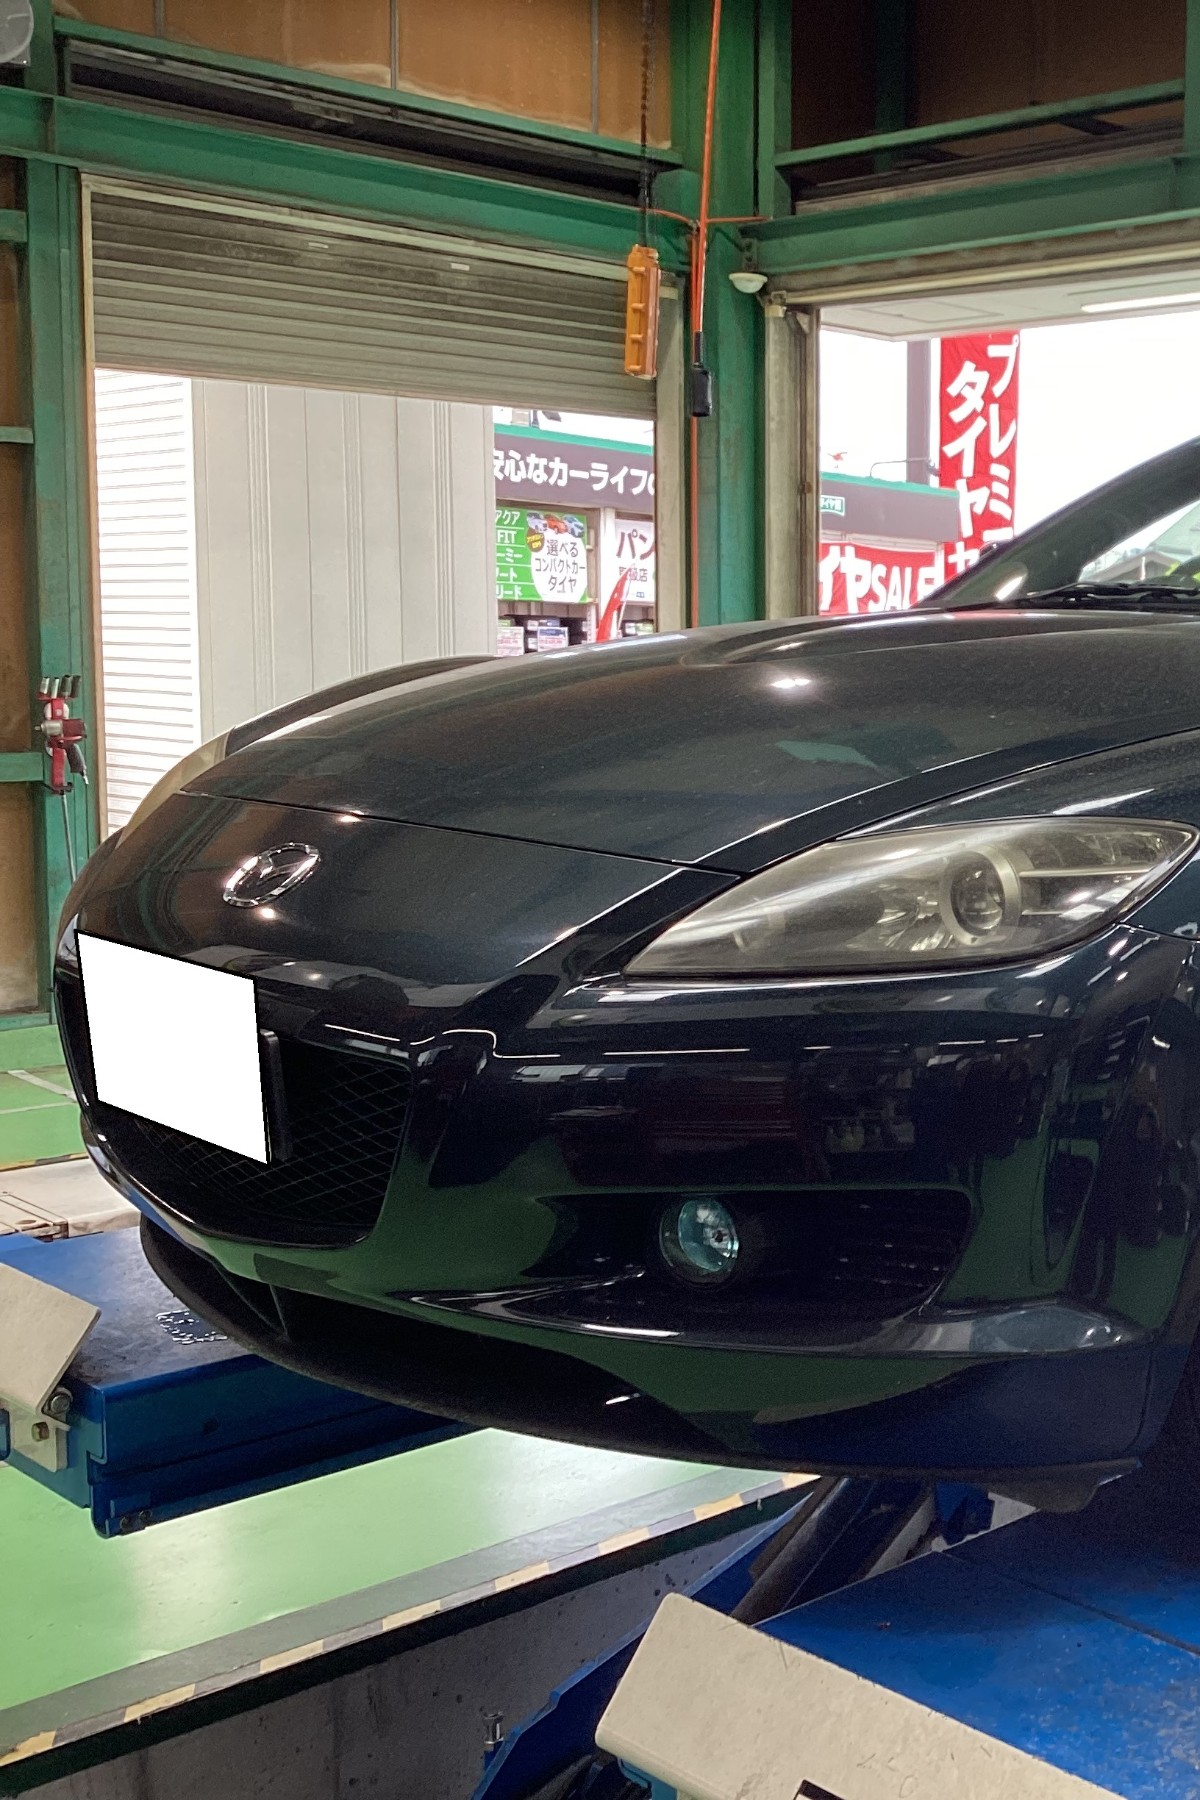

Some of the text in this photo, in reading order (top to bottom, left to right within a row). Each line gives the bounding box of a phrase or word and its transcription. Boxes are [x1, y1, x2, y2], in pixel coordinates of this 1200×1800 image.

[546, 539, 579, 558] 選べる
[548, 575, 577, 593] タイヤ
